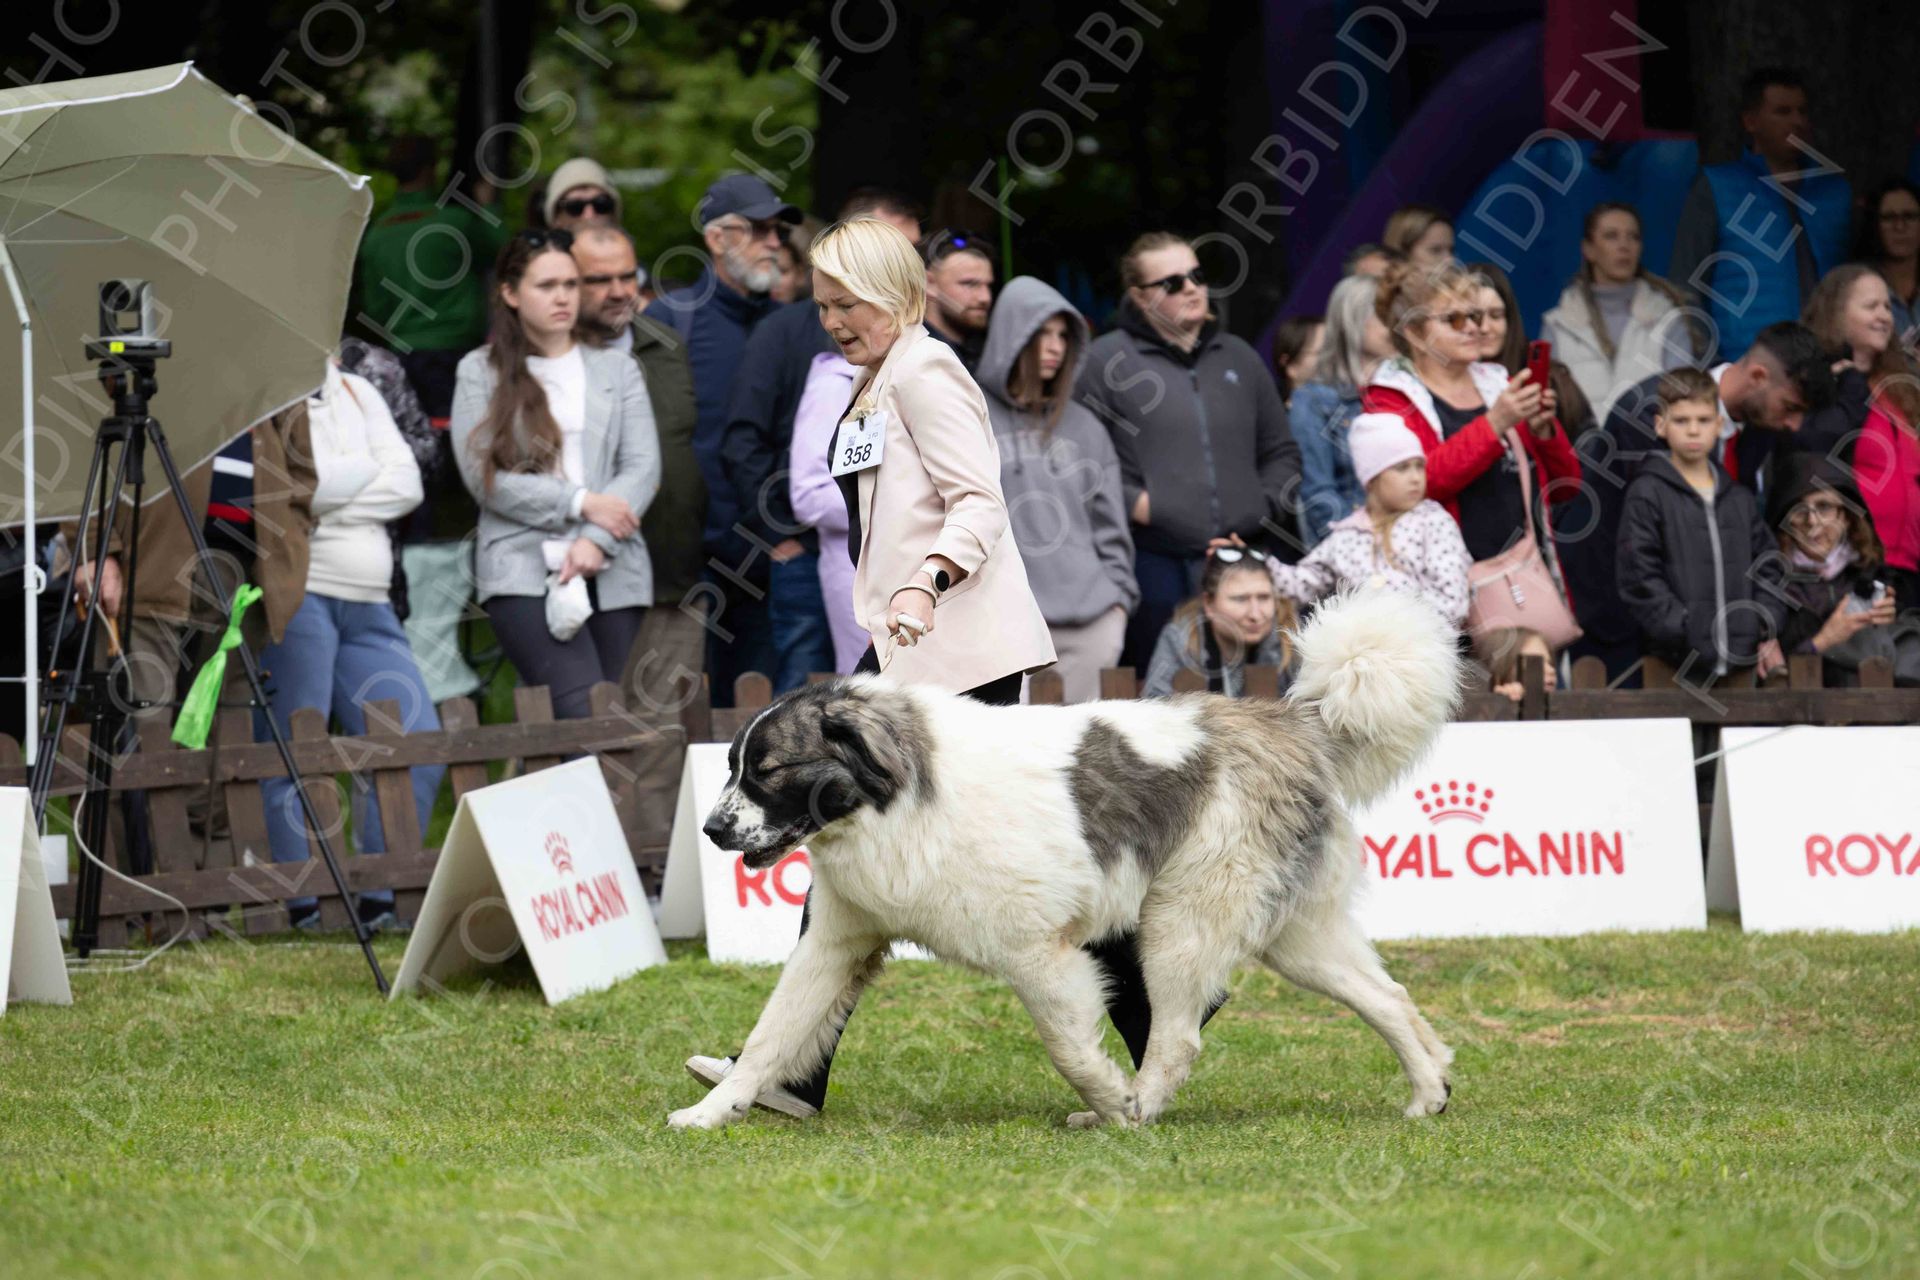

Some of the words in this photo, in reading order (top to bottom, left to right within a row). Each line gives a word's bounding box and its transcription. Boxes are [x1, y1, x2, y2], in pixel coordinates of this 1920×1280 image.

[843, 443, 873, 467] 358
[1359, 834, 1454, 879] YAL
[1465, 831, 1625, 877] CANIN
